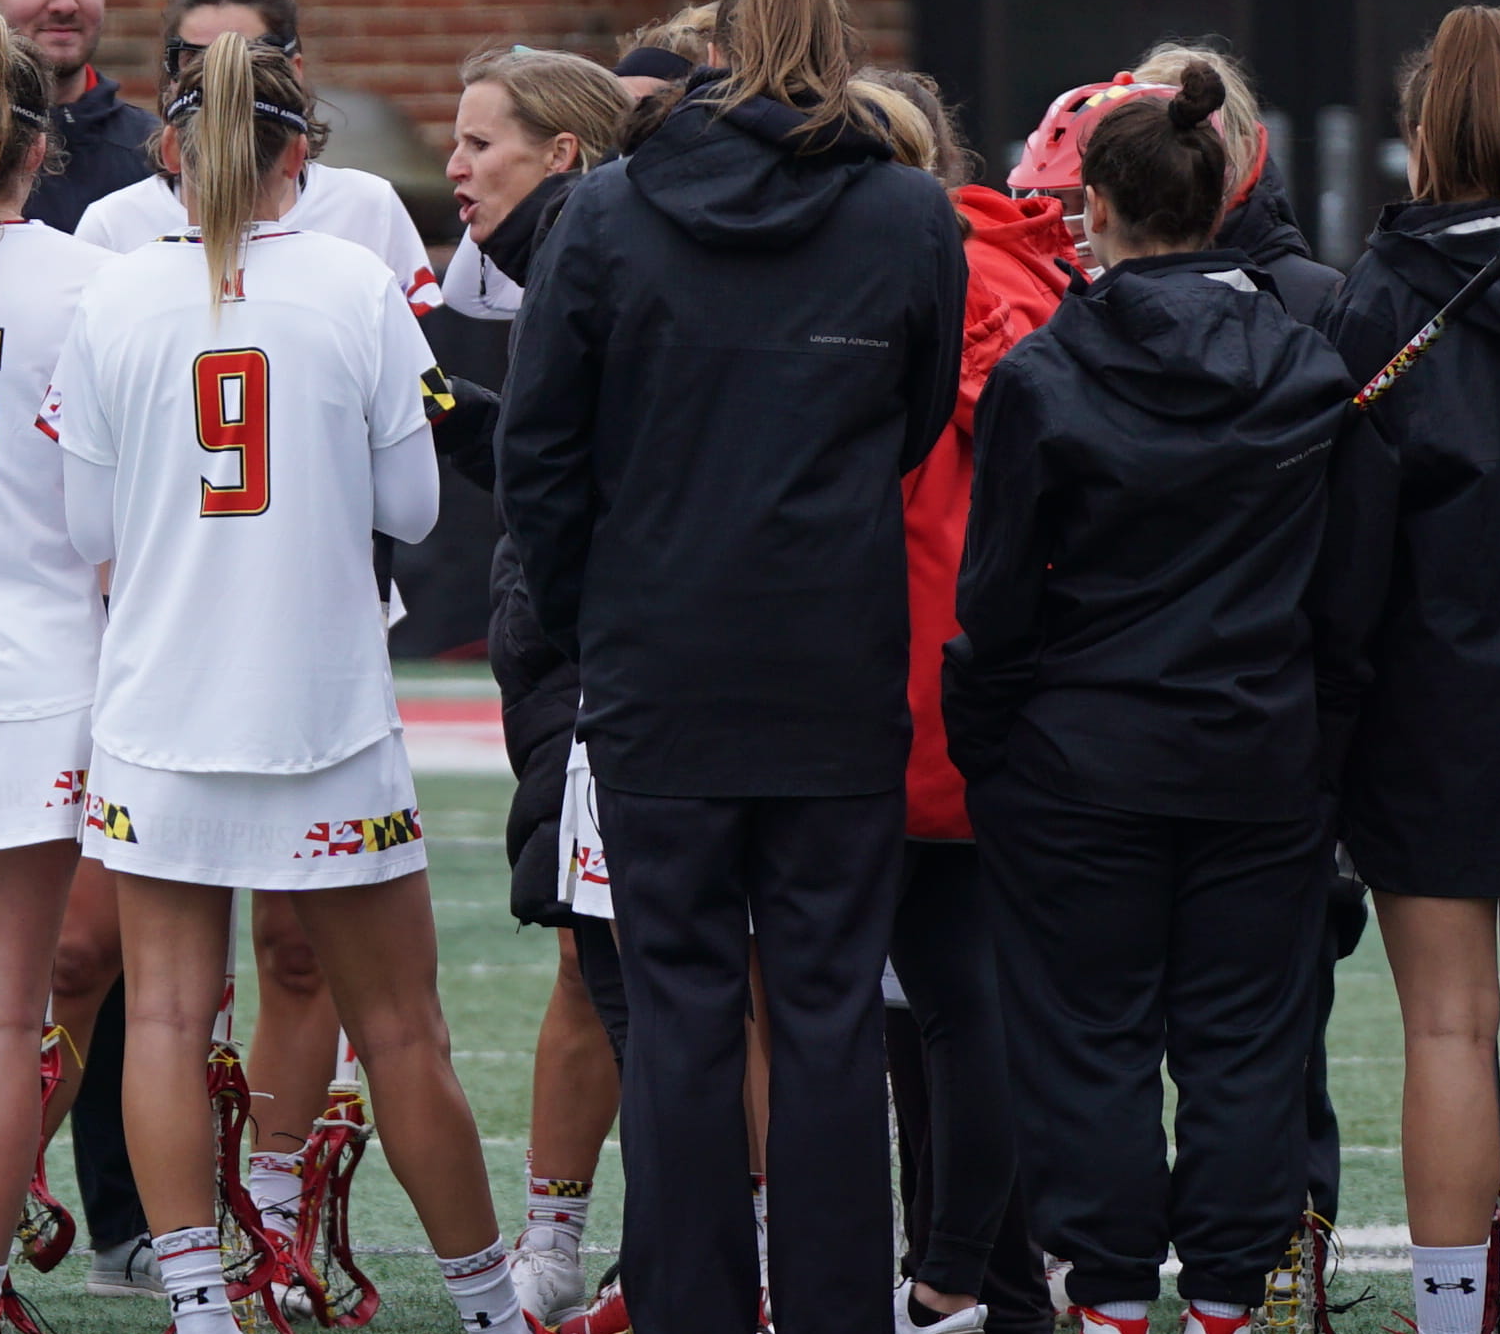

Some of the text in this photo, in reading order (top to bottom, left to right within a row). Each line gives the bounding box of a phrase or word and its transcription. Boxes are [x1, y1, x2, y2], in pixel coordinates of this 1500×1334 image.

[810, 334, 889, 348] UNDER ARMOUR
[192, 347, 271, 518] 9
